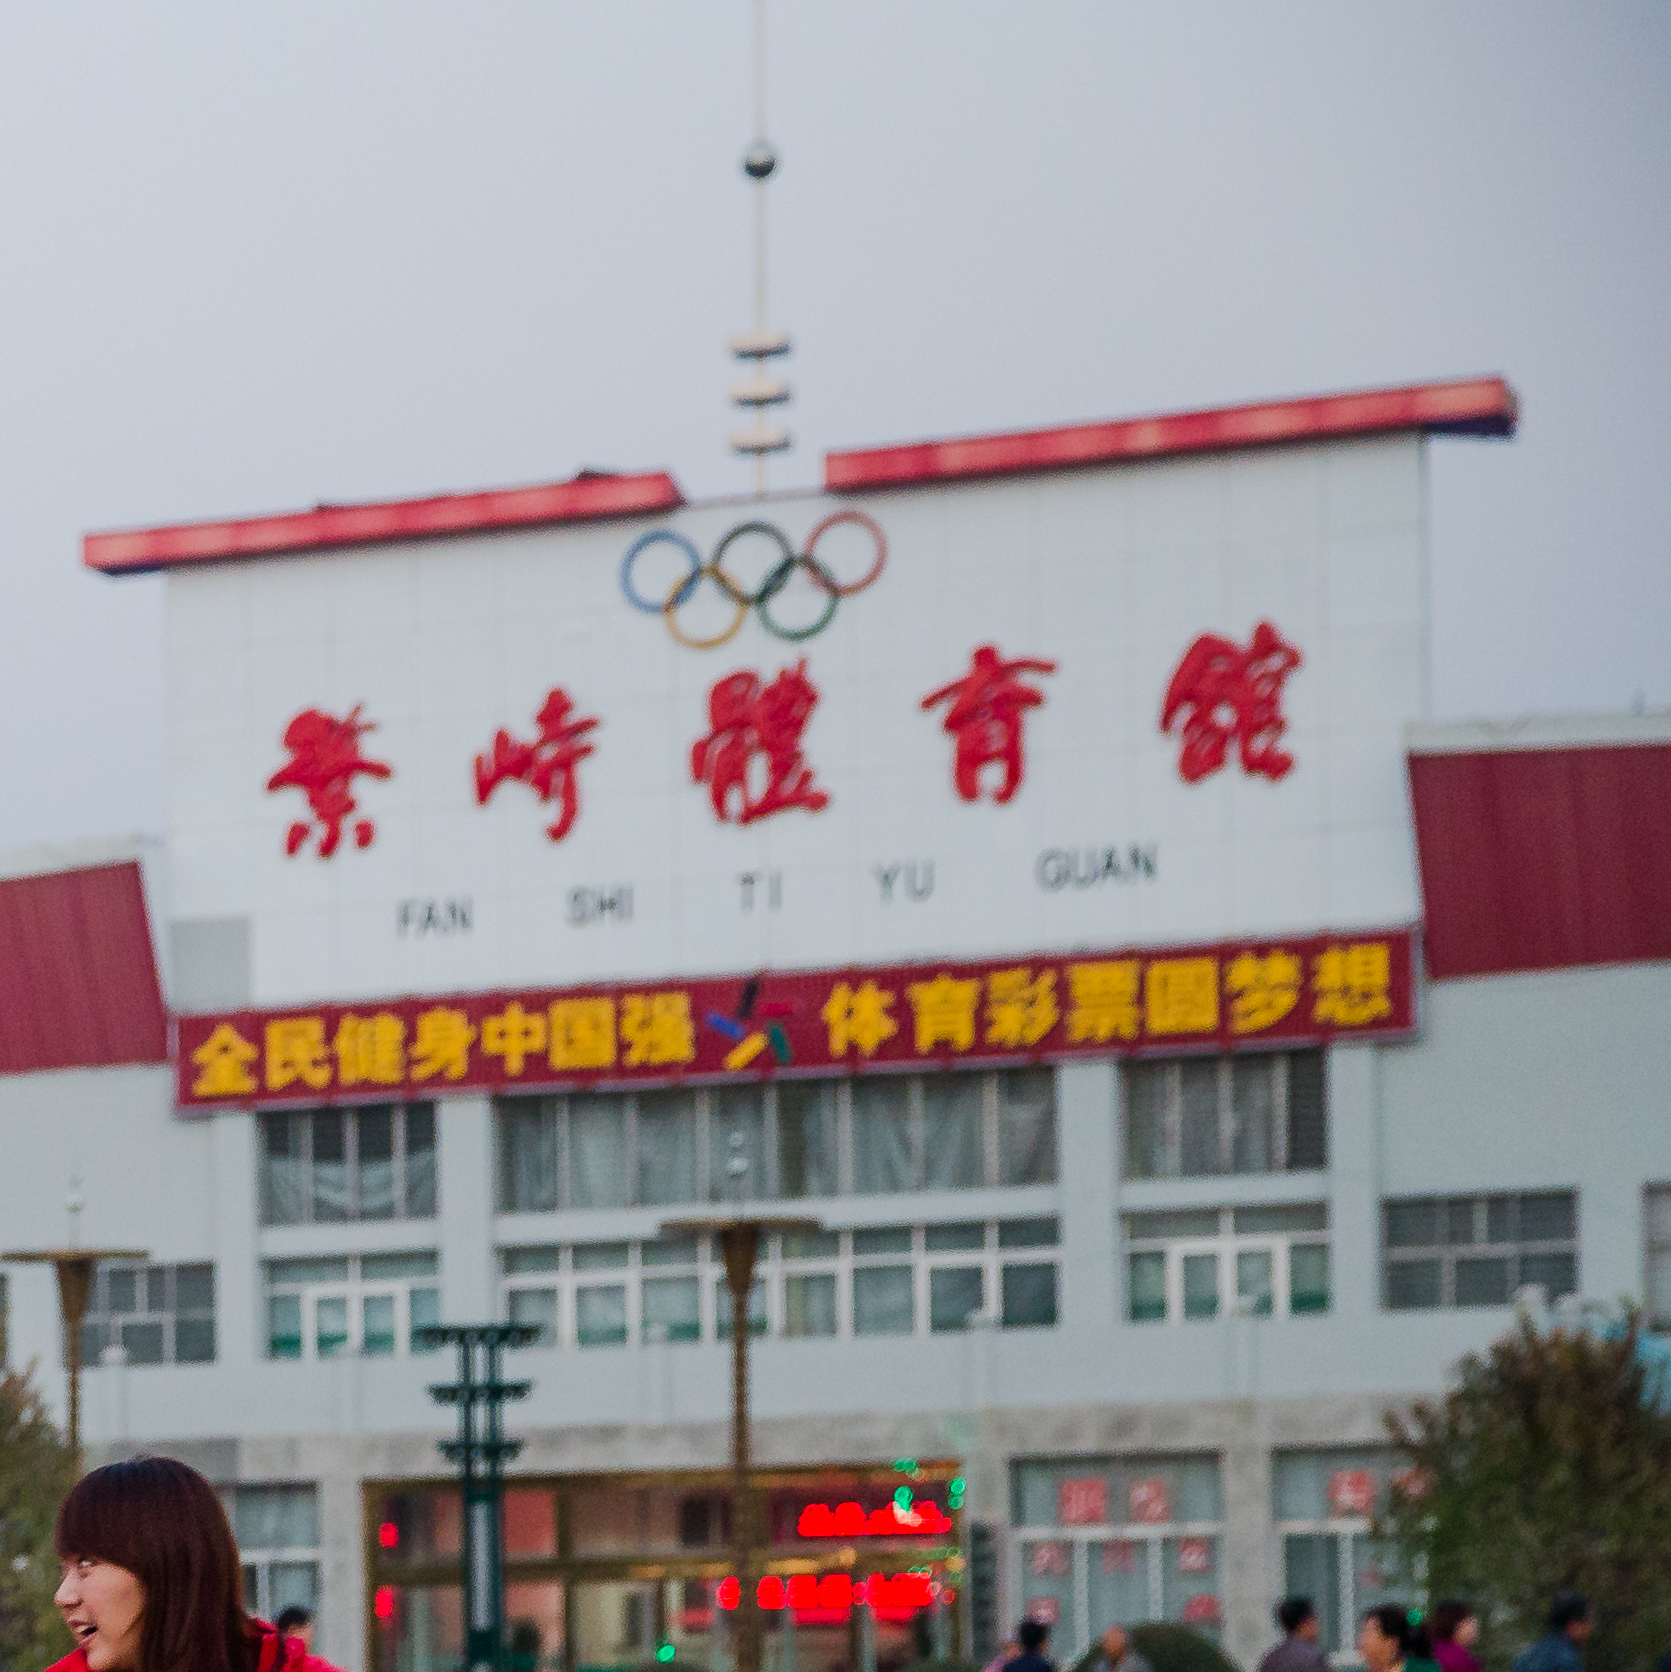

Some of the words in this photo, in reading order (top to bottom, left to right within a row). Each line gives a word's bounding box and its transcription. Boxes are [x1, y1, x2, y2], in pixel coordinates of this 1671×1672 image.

[396, 898, 474, 935] FAN
[566, 886, 634, 929] SHI
[737, 871, 782, 910] TI
[873, 861, 936, 902] YU
[1035, 843, 1158, 892] GUAN
[192, 991, 695, 1097] 全民健身中国强
